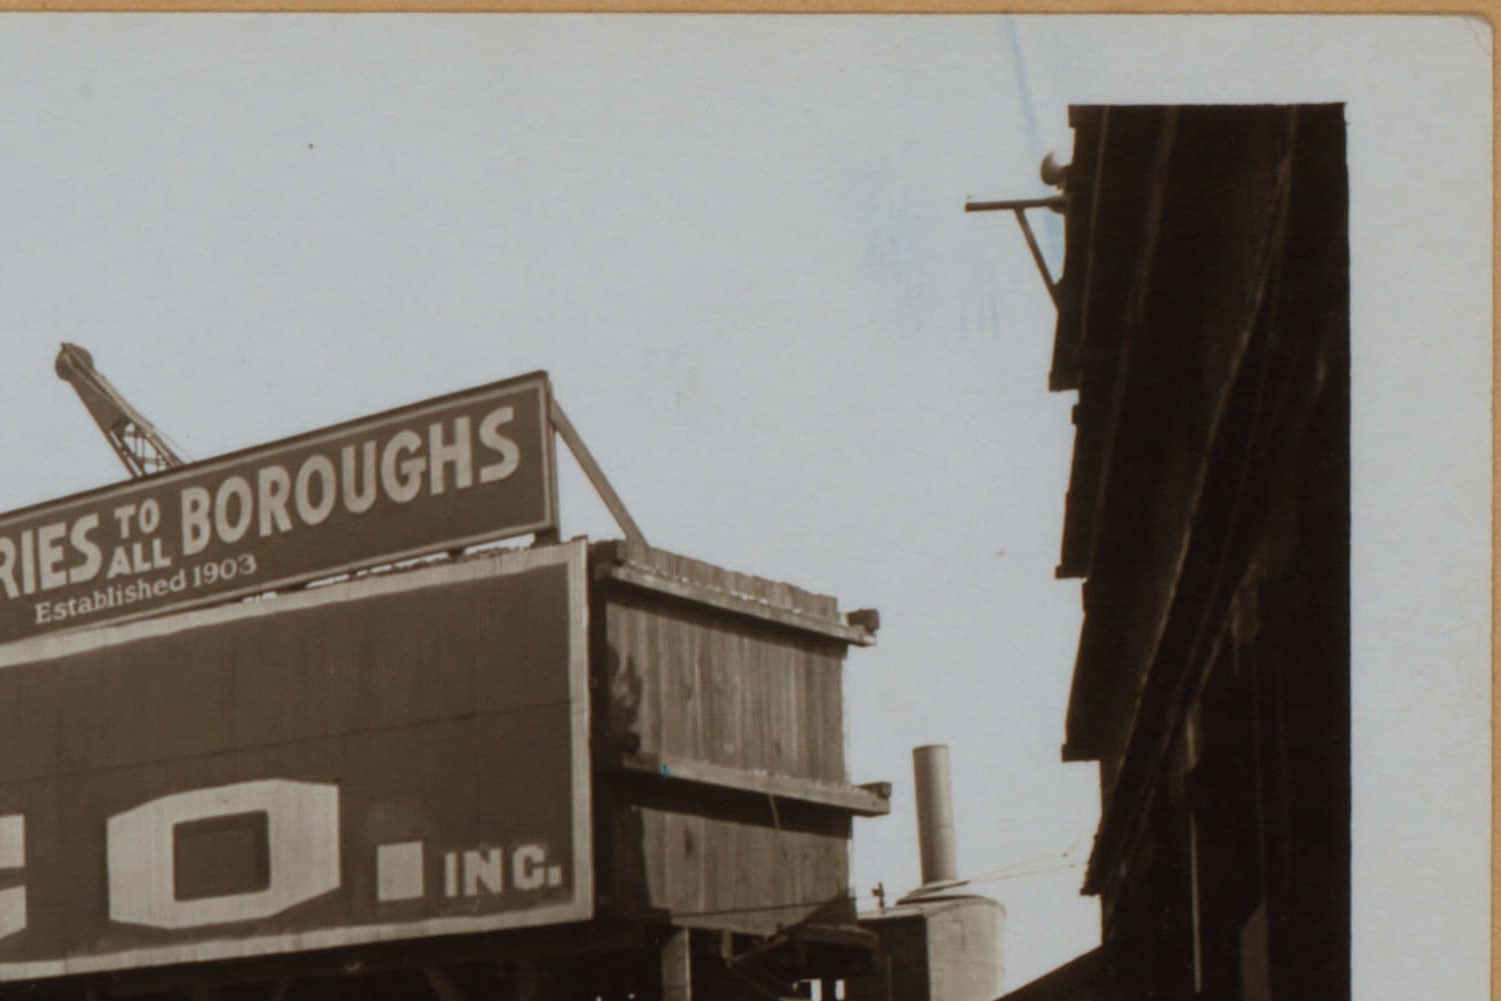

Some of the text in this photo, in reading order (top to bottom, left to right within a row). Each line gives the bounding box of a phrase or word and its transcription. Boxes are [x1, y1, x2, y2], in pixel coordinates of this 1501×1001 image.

[180, 406, 520, 557] BOROUGHS
[114, 498, 160, 539] TO
[106, 538, 171, 579] ALL
[34, 553, 258, 625] Established 1903
[444, 844, 561, 897] INC.
